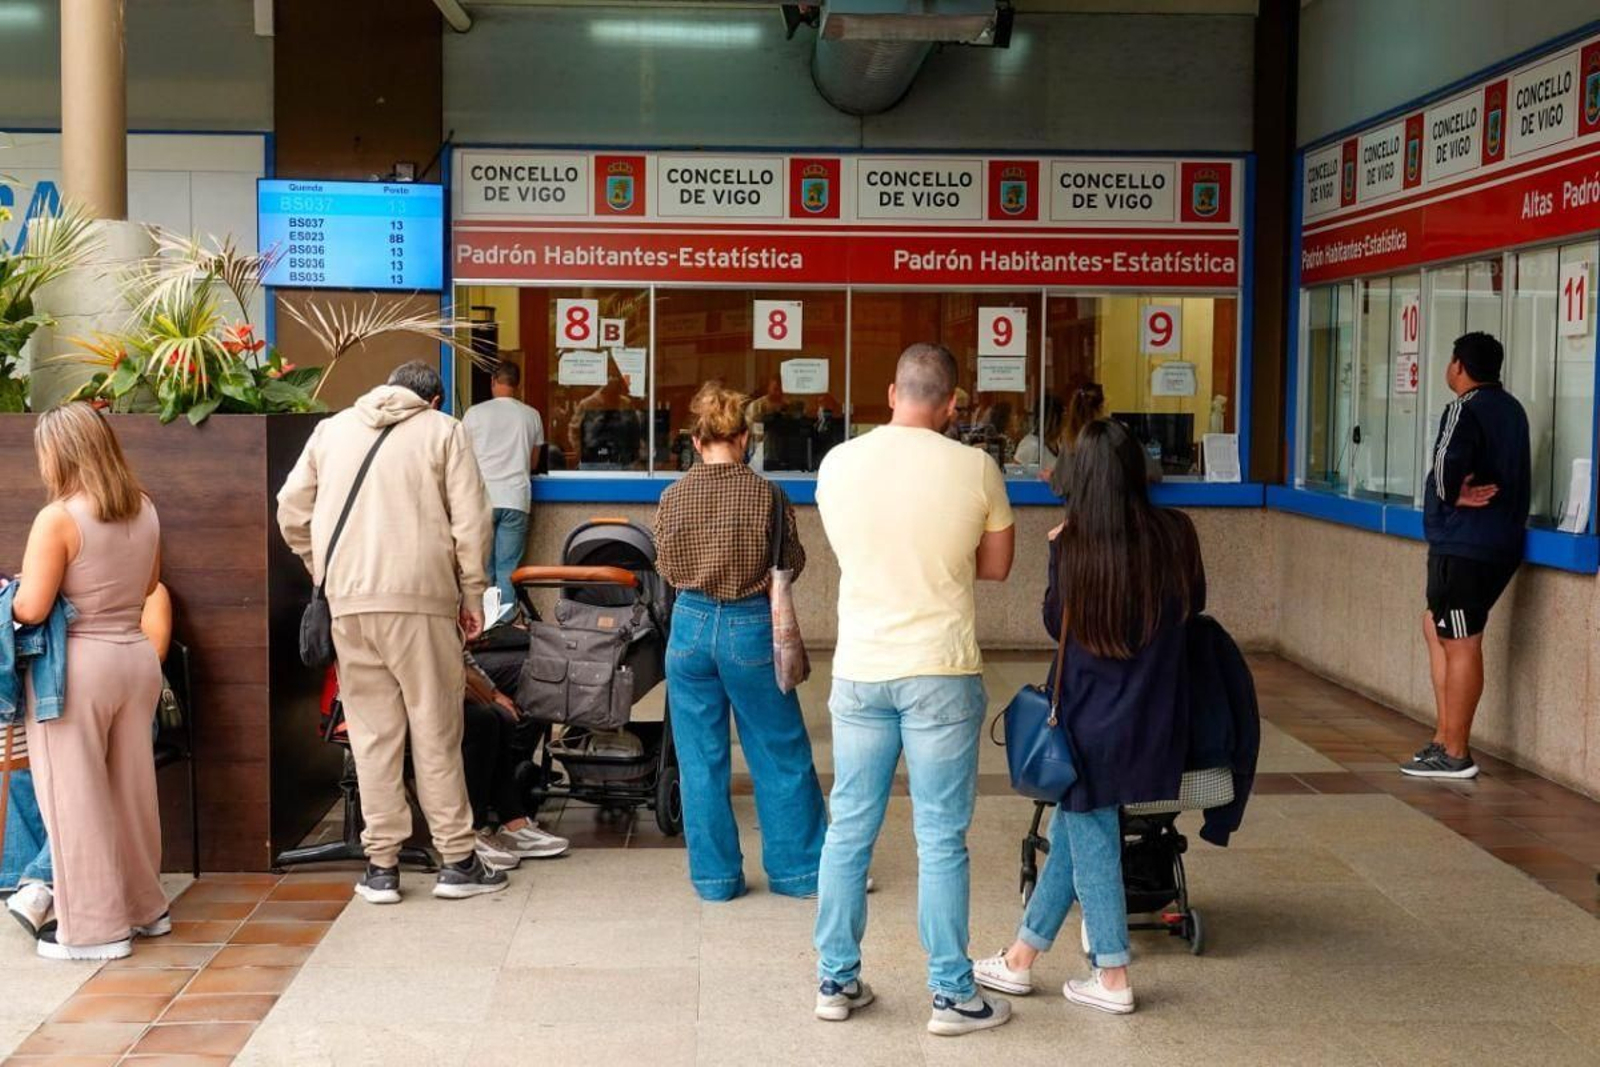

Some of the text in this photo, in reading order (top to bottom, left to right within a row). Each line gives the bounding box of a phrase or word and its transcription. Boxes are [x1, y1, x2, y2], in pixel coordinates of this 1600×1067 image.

[1516, 71, 1572, 110] CONCELLO
[1432, 107, 1477, 140] CONCELLO
[1521, 103, 1564, 136] DE VIGO
[1364, 136, 1399, 164] CONCELLO
[1436, 135, 1471, 164] DE VIGO
[471, 165, 578, 182] CONCELLO
[667, 168, 774, 185] CONCELLO
[867, 171, 973, 187] CONCELLO
[1060, 173, 1166, 190] CONCELLO
[1366, 161, 1394, 186] DE VIGO
[289, 184, 323, 192] Quenda
[484, 186, 566, 203] DE VIGO
[680, 188, 761, 205] DE VIGO
[280, 196, 332, 212] BS037
[879, 191, 960, 208] DE VIGO
[1072, 193, 1152, 210] DE VIGO
[1521, 189, 1553, 220] Altas
[289, 218, 404, 230] BS037 13
[289, 231, 404, 244] ES023 8B
[289, 245, 404, 257] BS036 13
[456, 244, 803, 269] Padrón Habitantes-Estatística
[289, 258, 404, 271] BS036 13
[893, 248, 1235, 274] Padrón Habitantes-Estatística
[289, 272, 404, 284] BS035 13
[1564, 275, 1585, 322] 11
[564, 305, 590, 341] 8
[604, 323, 621, 341] B
[768, 309, 788, 340] 8
[992, 315, 1013, 347] 9
[1149, 311, 1173, 347] 9
[1402, 304, 1418, 342] 10
